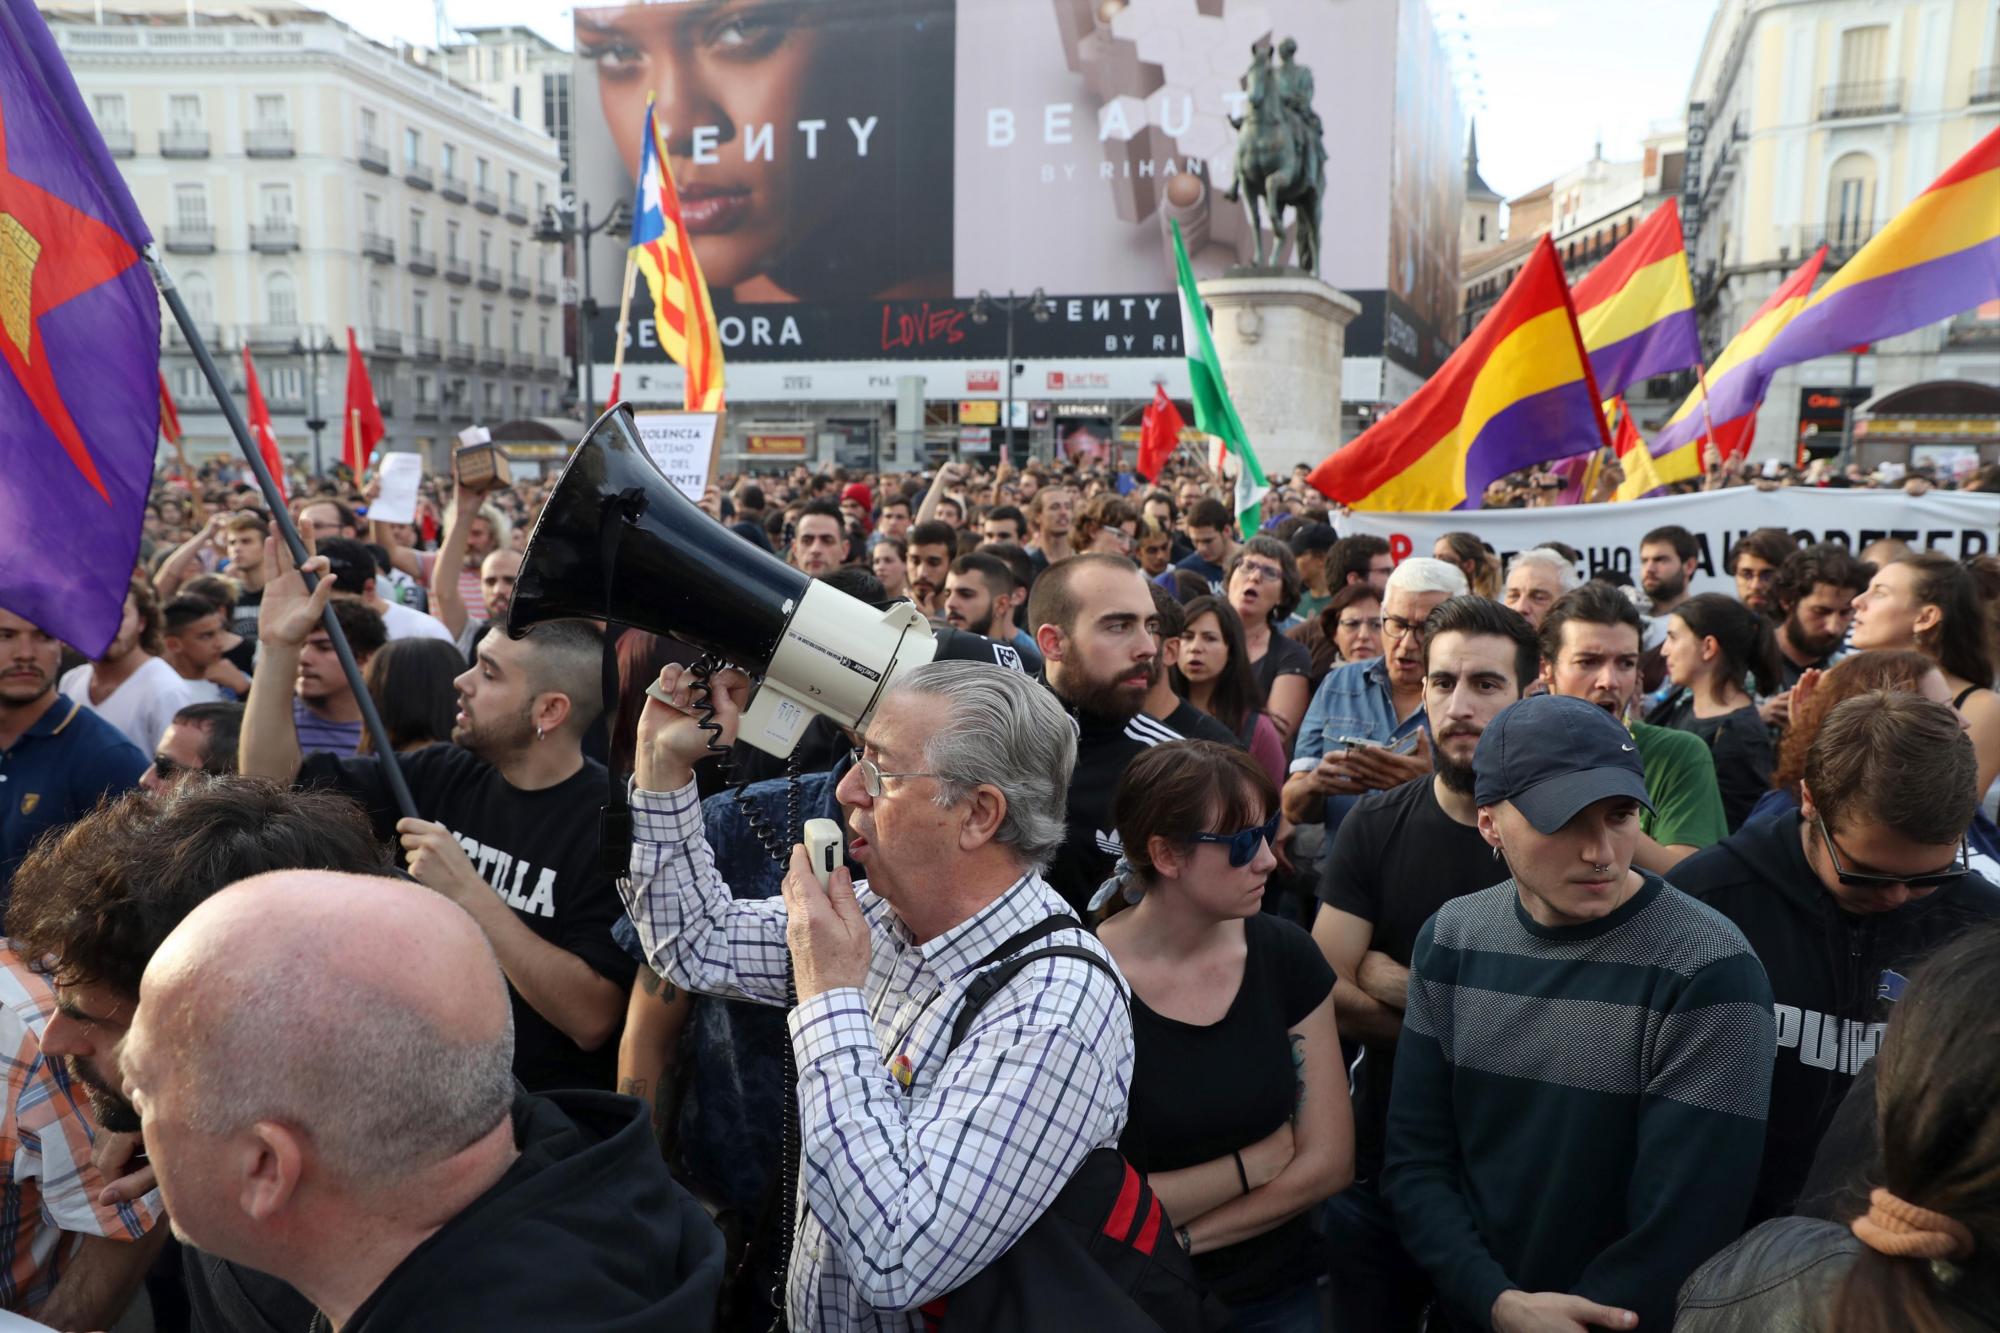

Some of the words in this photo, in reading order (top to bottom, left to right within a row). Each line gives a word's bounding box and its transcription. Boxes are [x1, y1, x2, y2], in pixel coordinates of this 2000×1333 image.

[661, 115, 879, 166] ENTY
[986, 91, 1248, 147] BEAUT
[1040, 162, 1077, 184] BY
[1099, 156, 1228, 180] RIHANN
[1686, 110, 1705, 194] HOTEL
[614, 315, 803, 349] SEORA
[880, 302, 968, 351] LOVES
[1104, 334, 1136, 352] BY
[434, 820, 558, 919] TILLA
[1773, 1002, 1888, 1077] PUM
